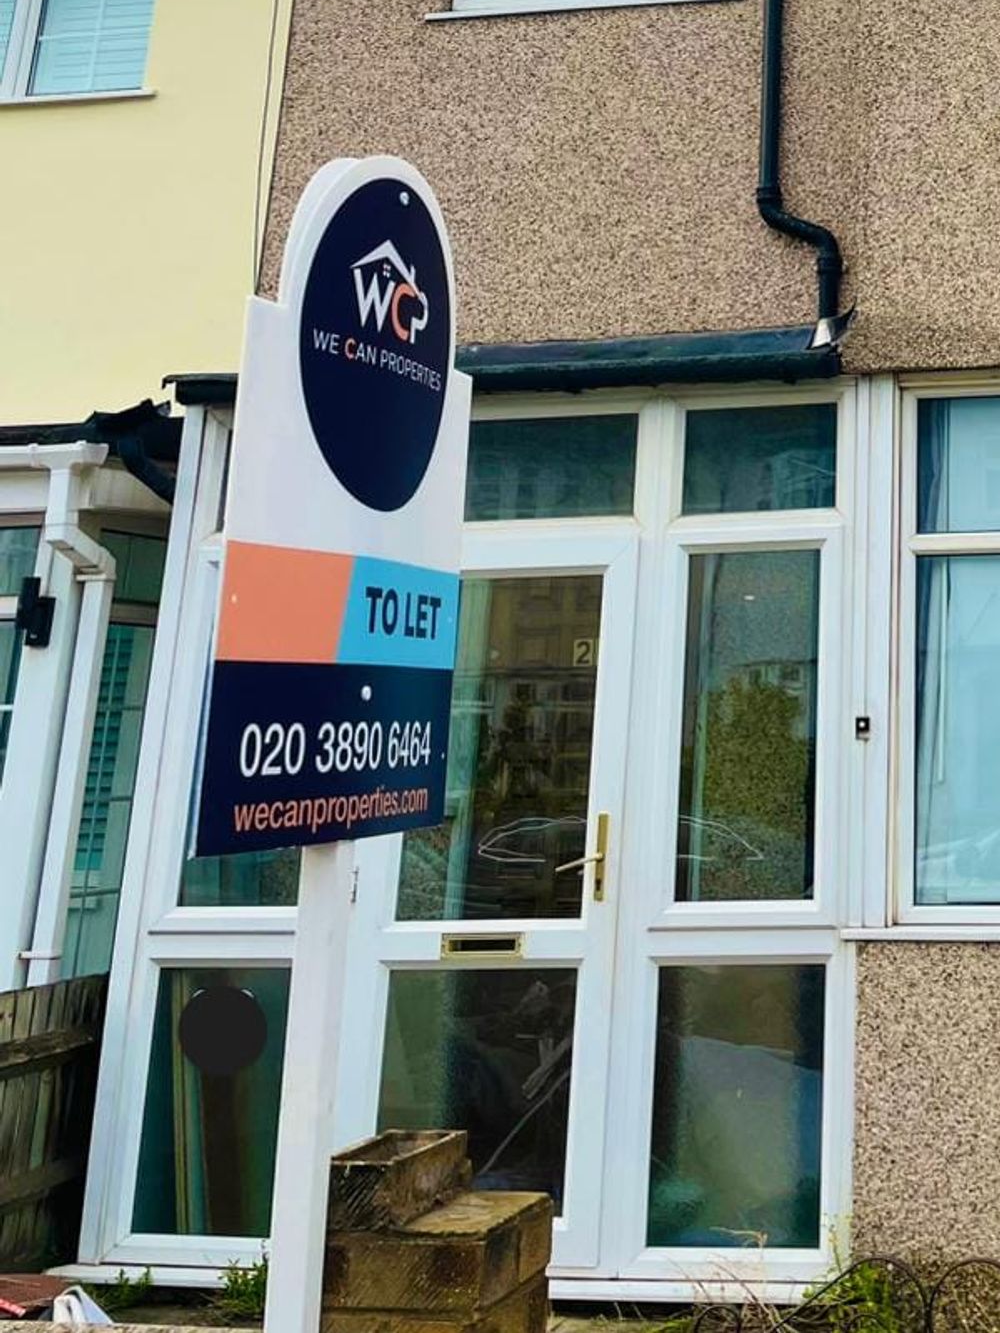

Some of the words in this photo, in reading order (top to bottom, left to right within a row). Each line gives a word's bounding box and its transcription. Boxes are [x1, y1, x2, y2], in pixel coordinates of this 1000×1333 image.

[313, 328, 340, 354] WE
[344, 337, 377, 364] CAN
[380, 349, 442, 391] PROPERTIES
[366, 586, 398, 635] TO
[404, 592, 441, 640] LET
[576, 641, 591, 664] 2
[240, 723, 306, 777] 020
[316, 721, 383, 773] 3890
[387, 721, 431, 769] 6464
[234, 786, 428, 833] wecanproperties.com
